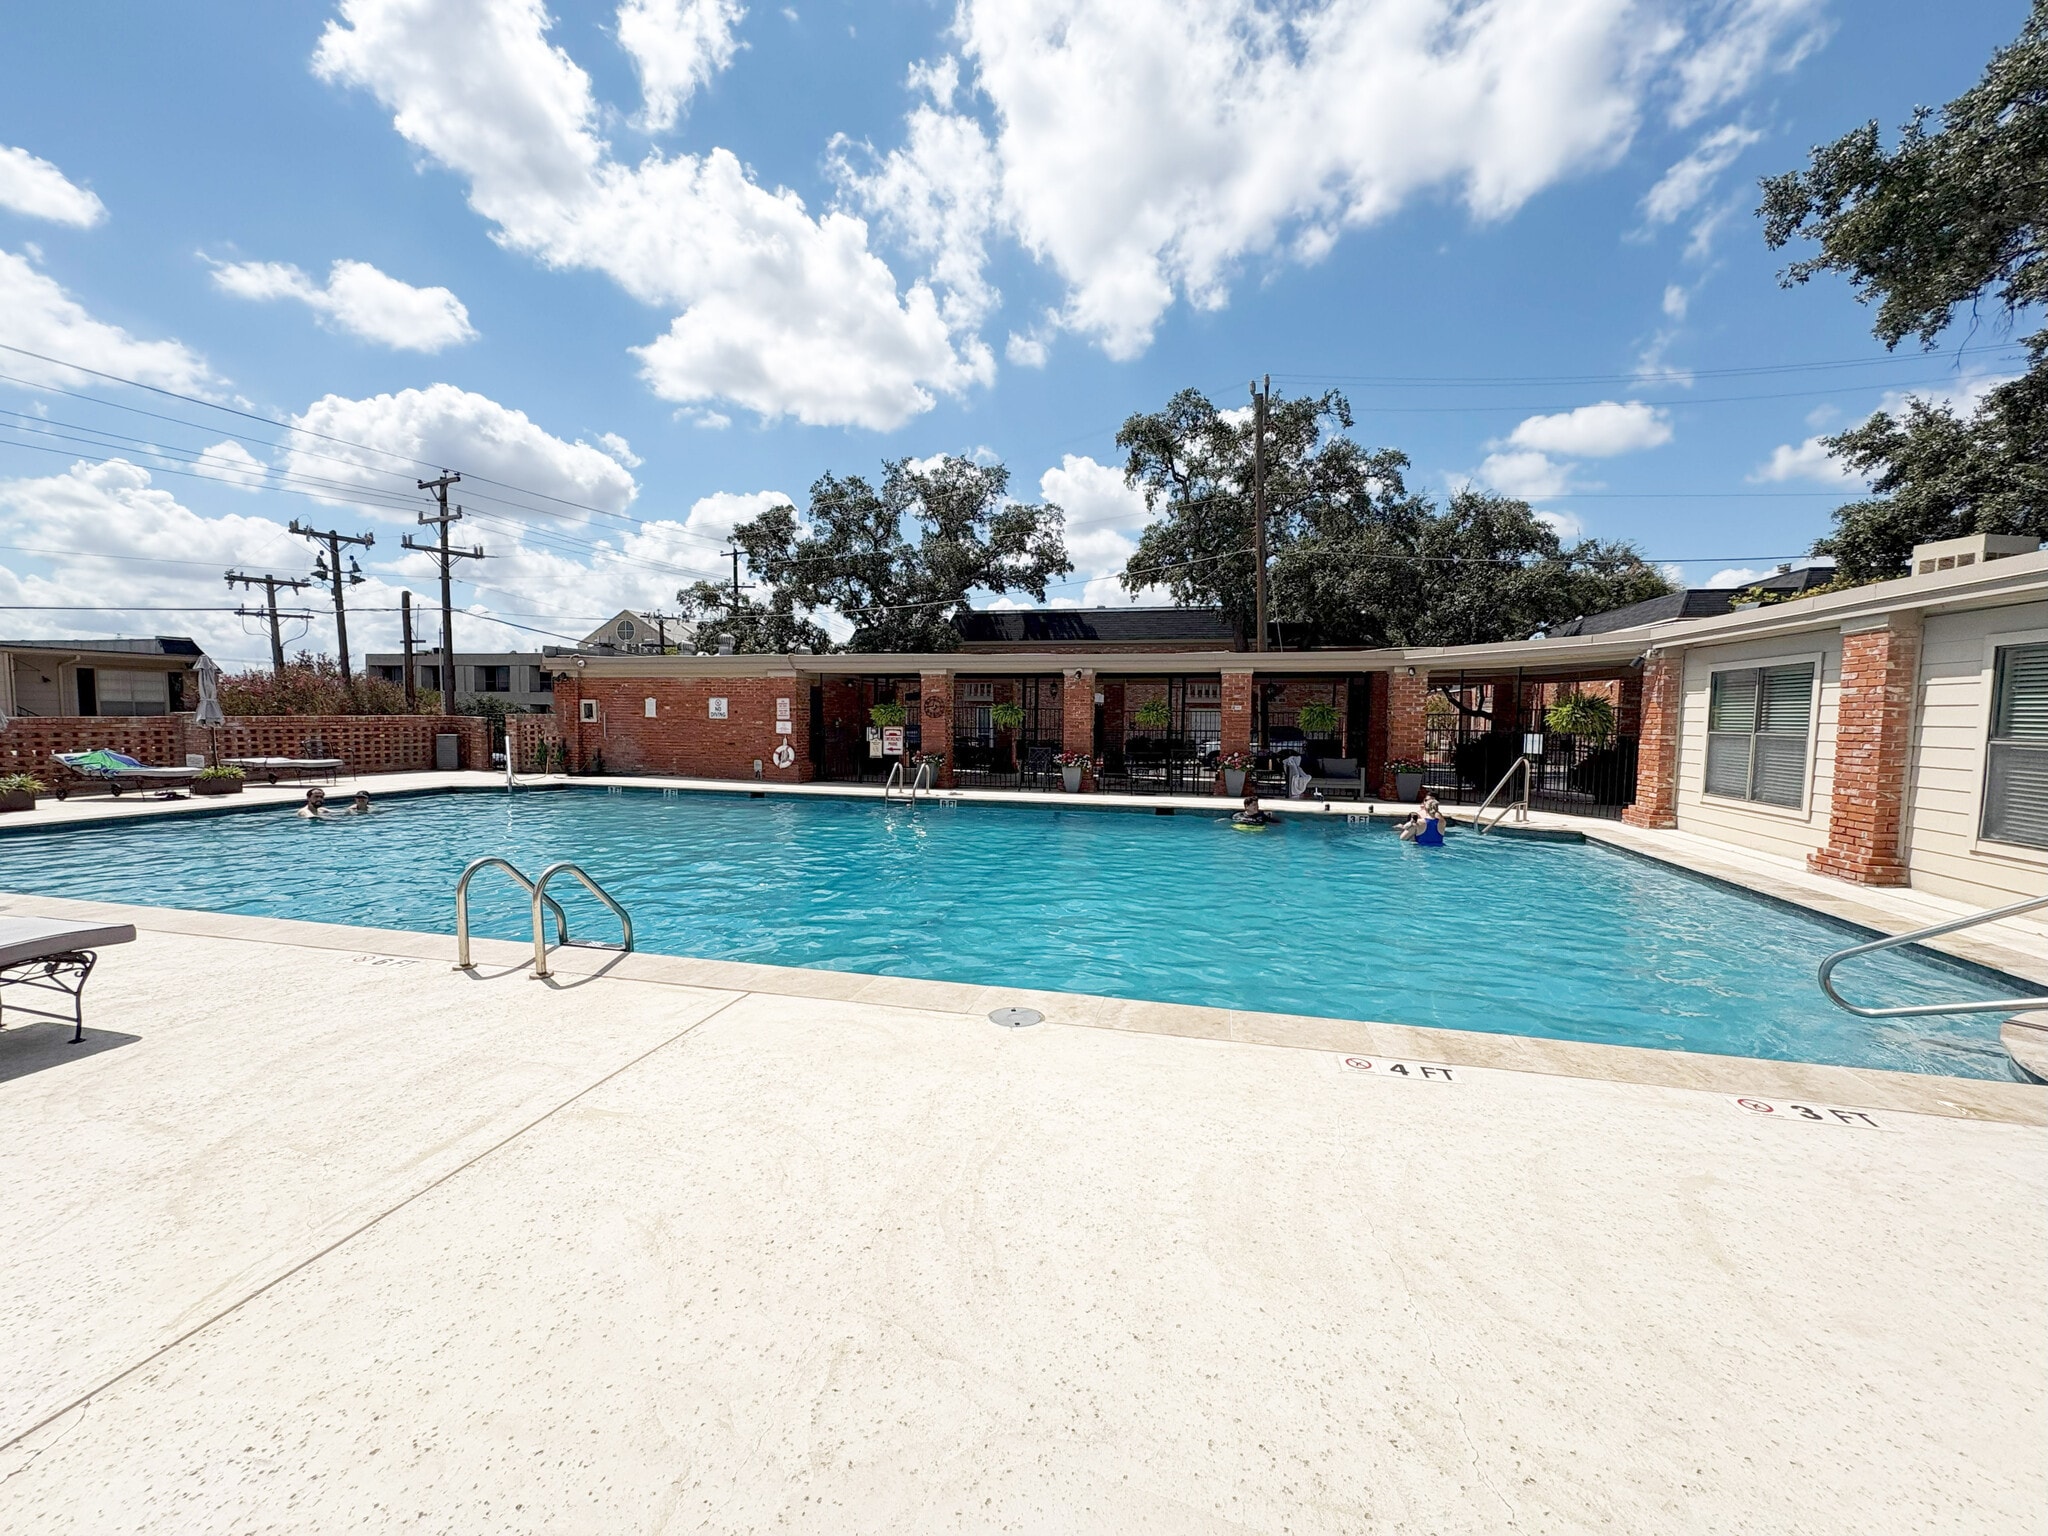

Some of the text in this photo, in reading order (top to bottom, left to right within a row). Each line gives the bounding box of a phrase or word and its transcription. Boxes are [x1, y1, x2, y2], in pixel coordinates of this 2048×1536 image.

[371, 958, 421, 968] 6 FT
[1389, 1063, 1410, 1076] 4
[1420, 1066, 1453, 1081] FT
[1790, 1105, 1880, 1128] 3 FT
